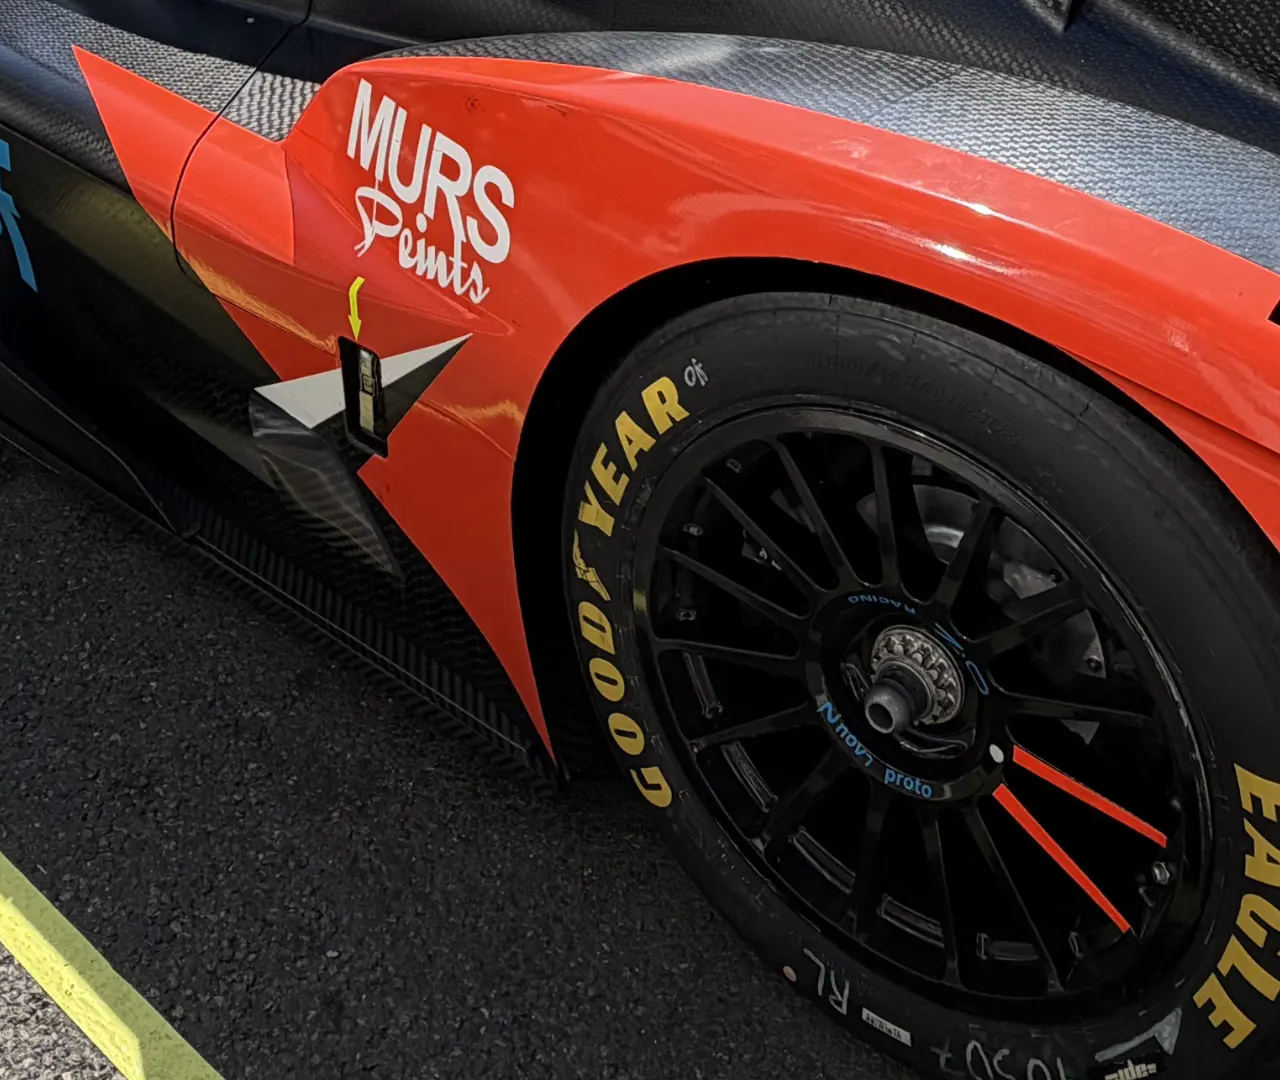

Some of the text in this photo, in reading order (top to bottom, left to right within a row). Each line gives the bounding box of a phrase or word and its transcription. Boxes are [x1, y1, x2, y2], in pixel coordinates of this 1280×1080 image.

[346, 77, 515, 265] MURS
[353, 185, 490, 305] Peints
[847, 594, 916, 616] RACING
[883, 768, 933, 799] proto
[802, 947, 850, 1016] RL
